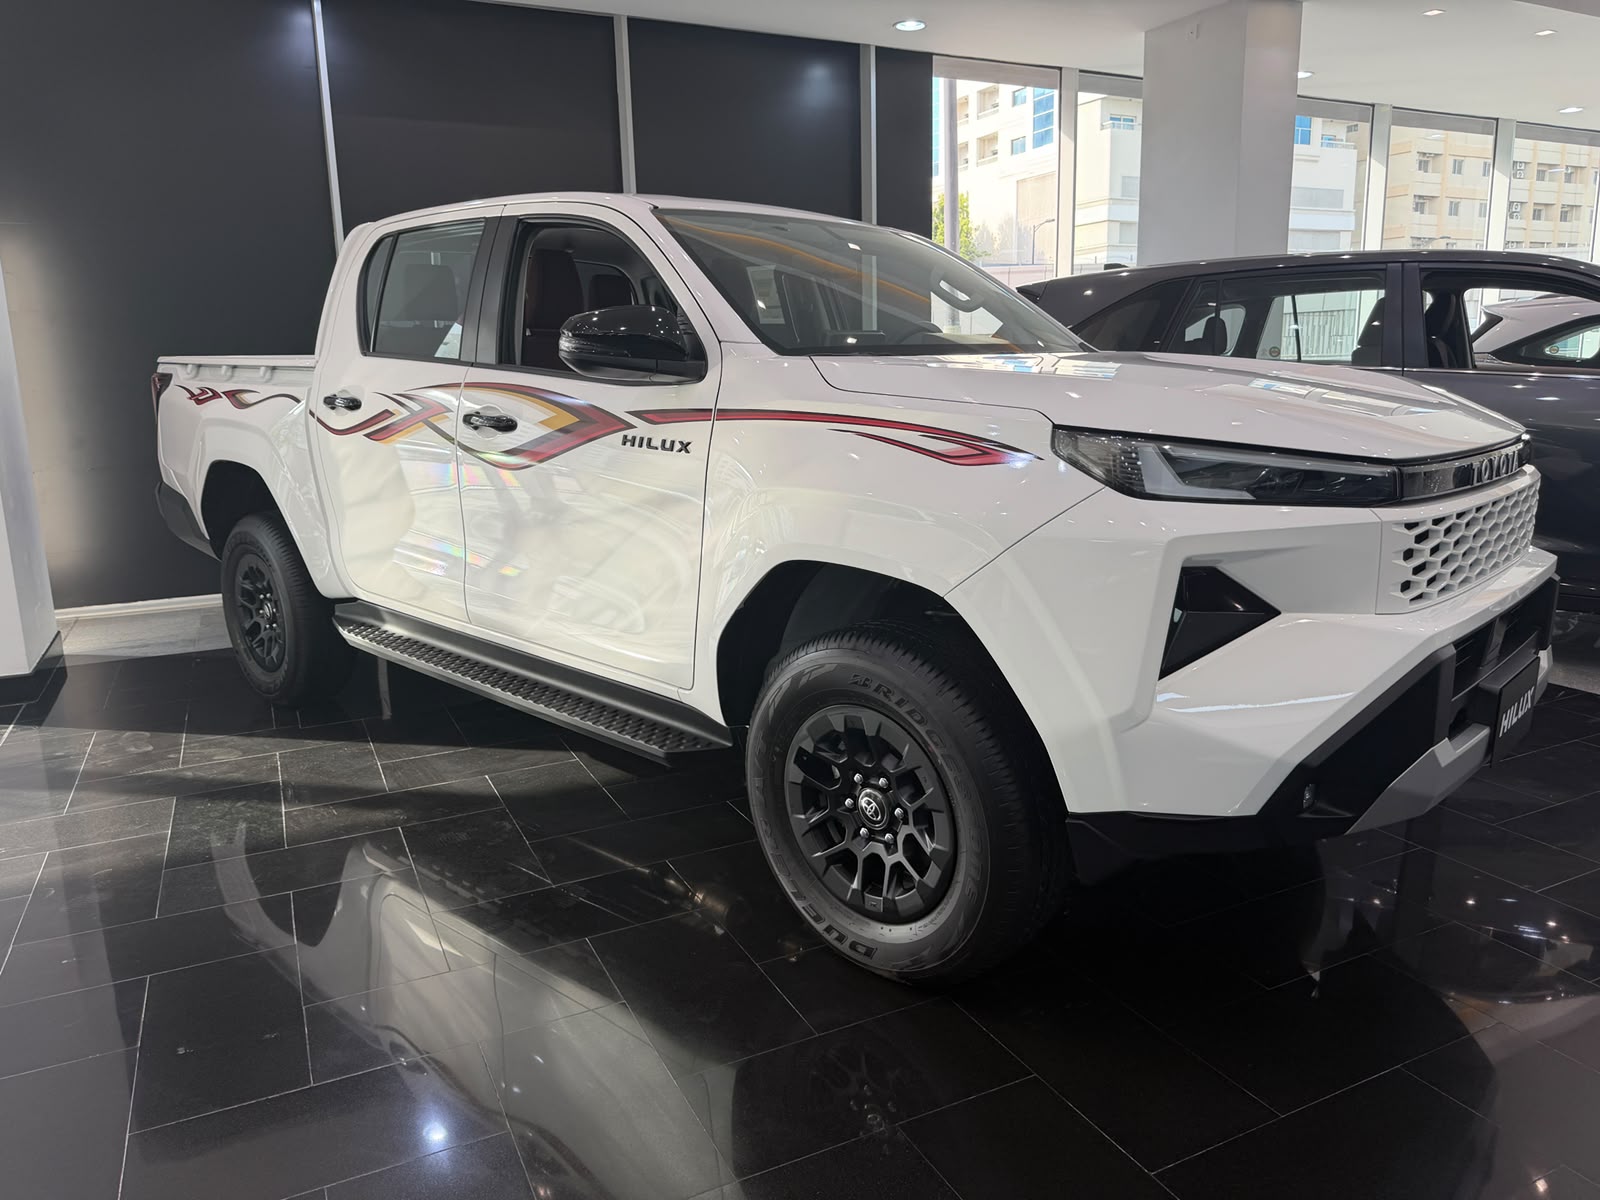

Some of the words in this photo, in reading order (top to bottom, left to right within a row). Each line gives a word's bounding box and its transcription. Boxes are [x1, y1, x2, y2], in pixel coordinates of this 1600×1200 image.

[621, 434, 692, 454] HILUX
[1472, 450, 1519, 485] TOYOTA
[1499, 686, 1534, 737] HILUX
